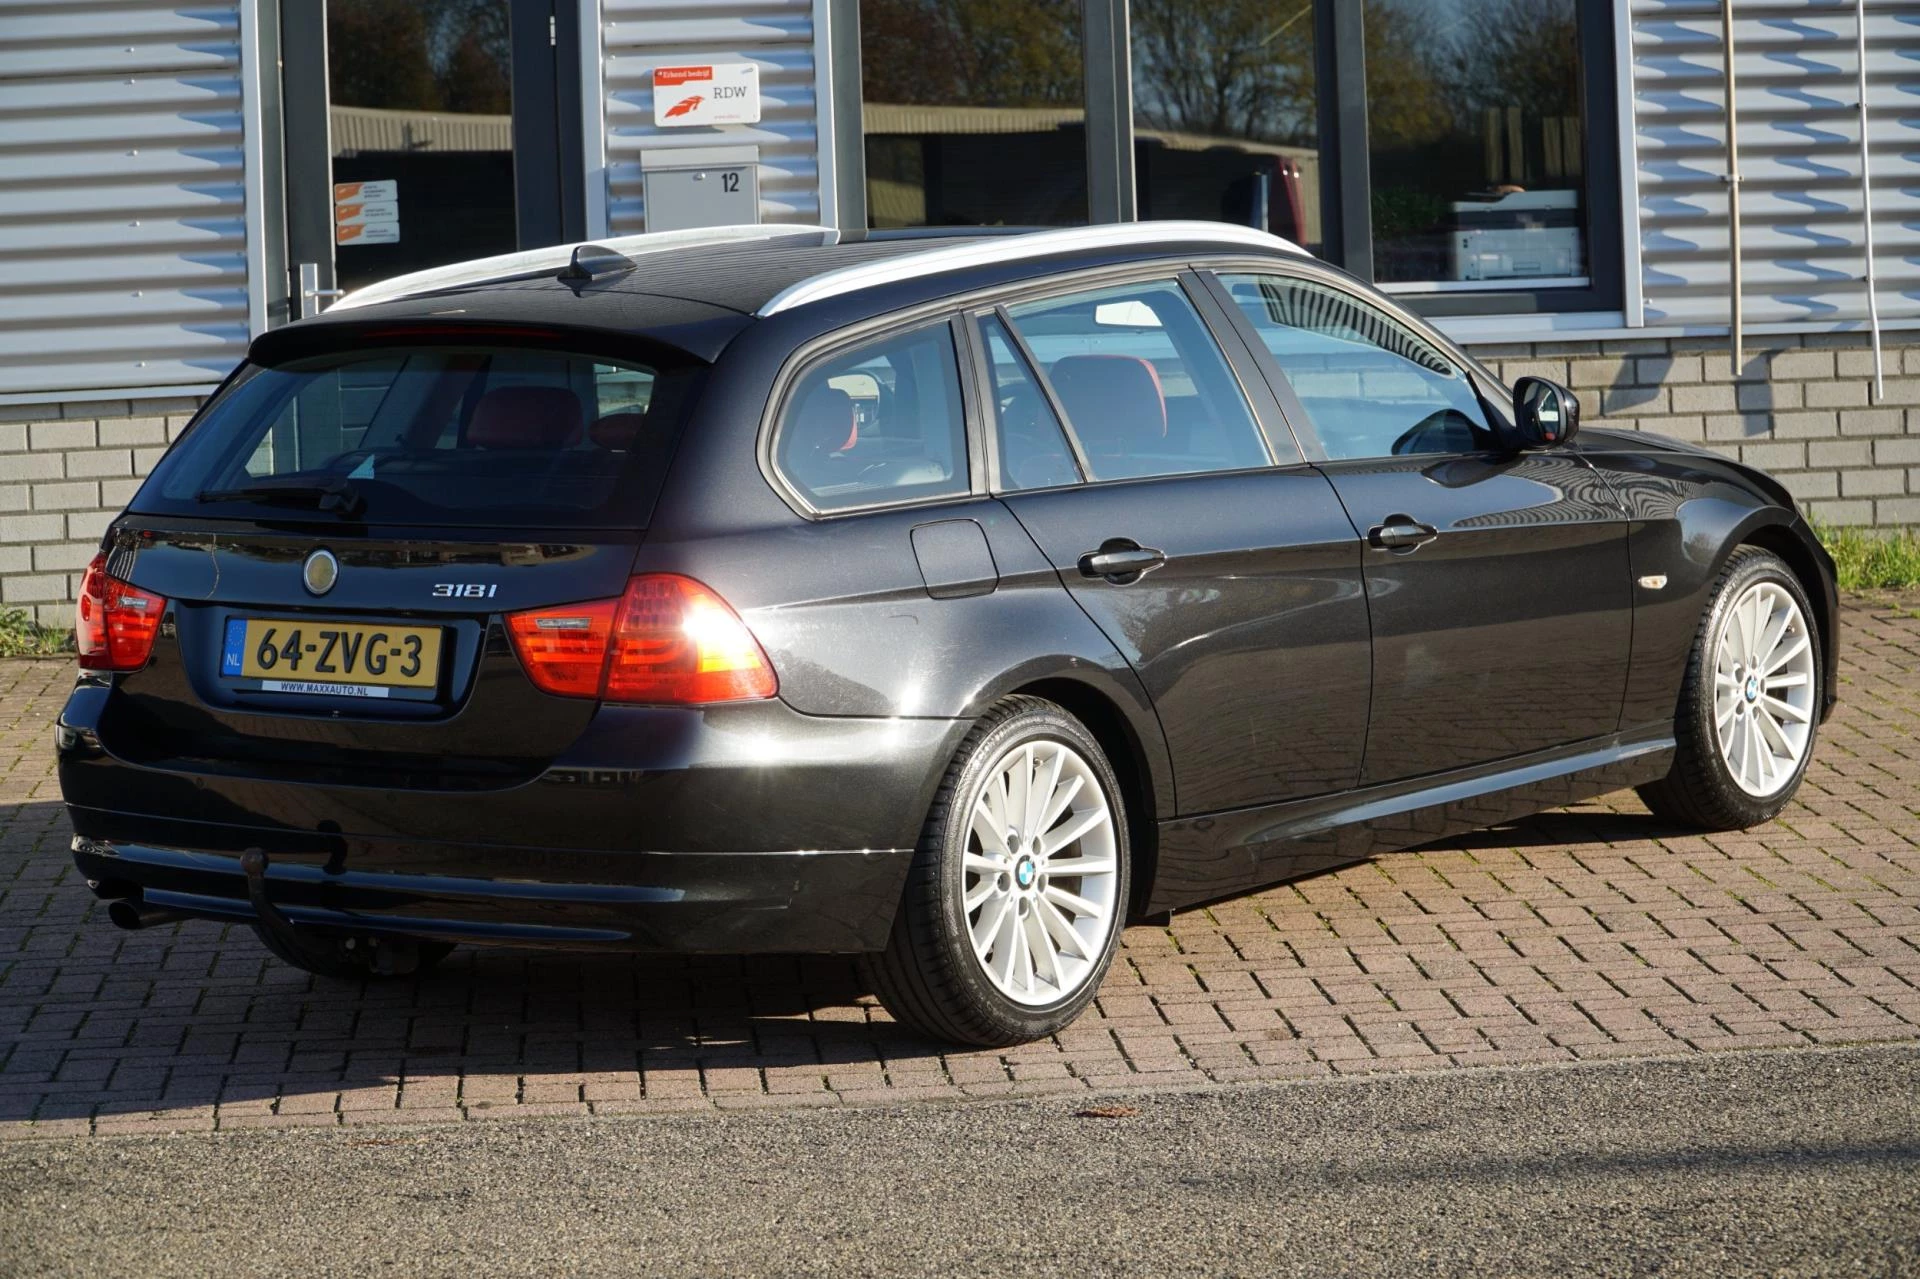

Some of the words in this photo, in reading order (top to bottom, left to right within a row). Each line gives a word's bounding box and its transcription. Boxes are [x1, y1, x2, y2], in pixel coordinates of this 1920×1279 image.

[713, 86, 747, 99] RDW
[721, 172, 740, 193] 12
[226, 652, 240, 667] NL
[256, 628, 423, 678] 64-ZVG-3
[281, 682, 369, 696] WWW.MAXXAUTO.NL
